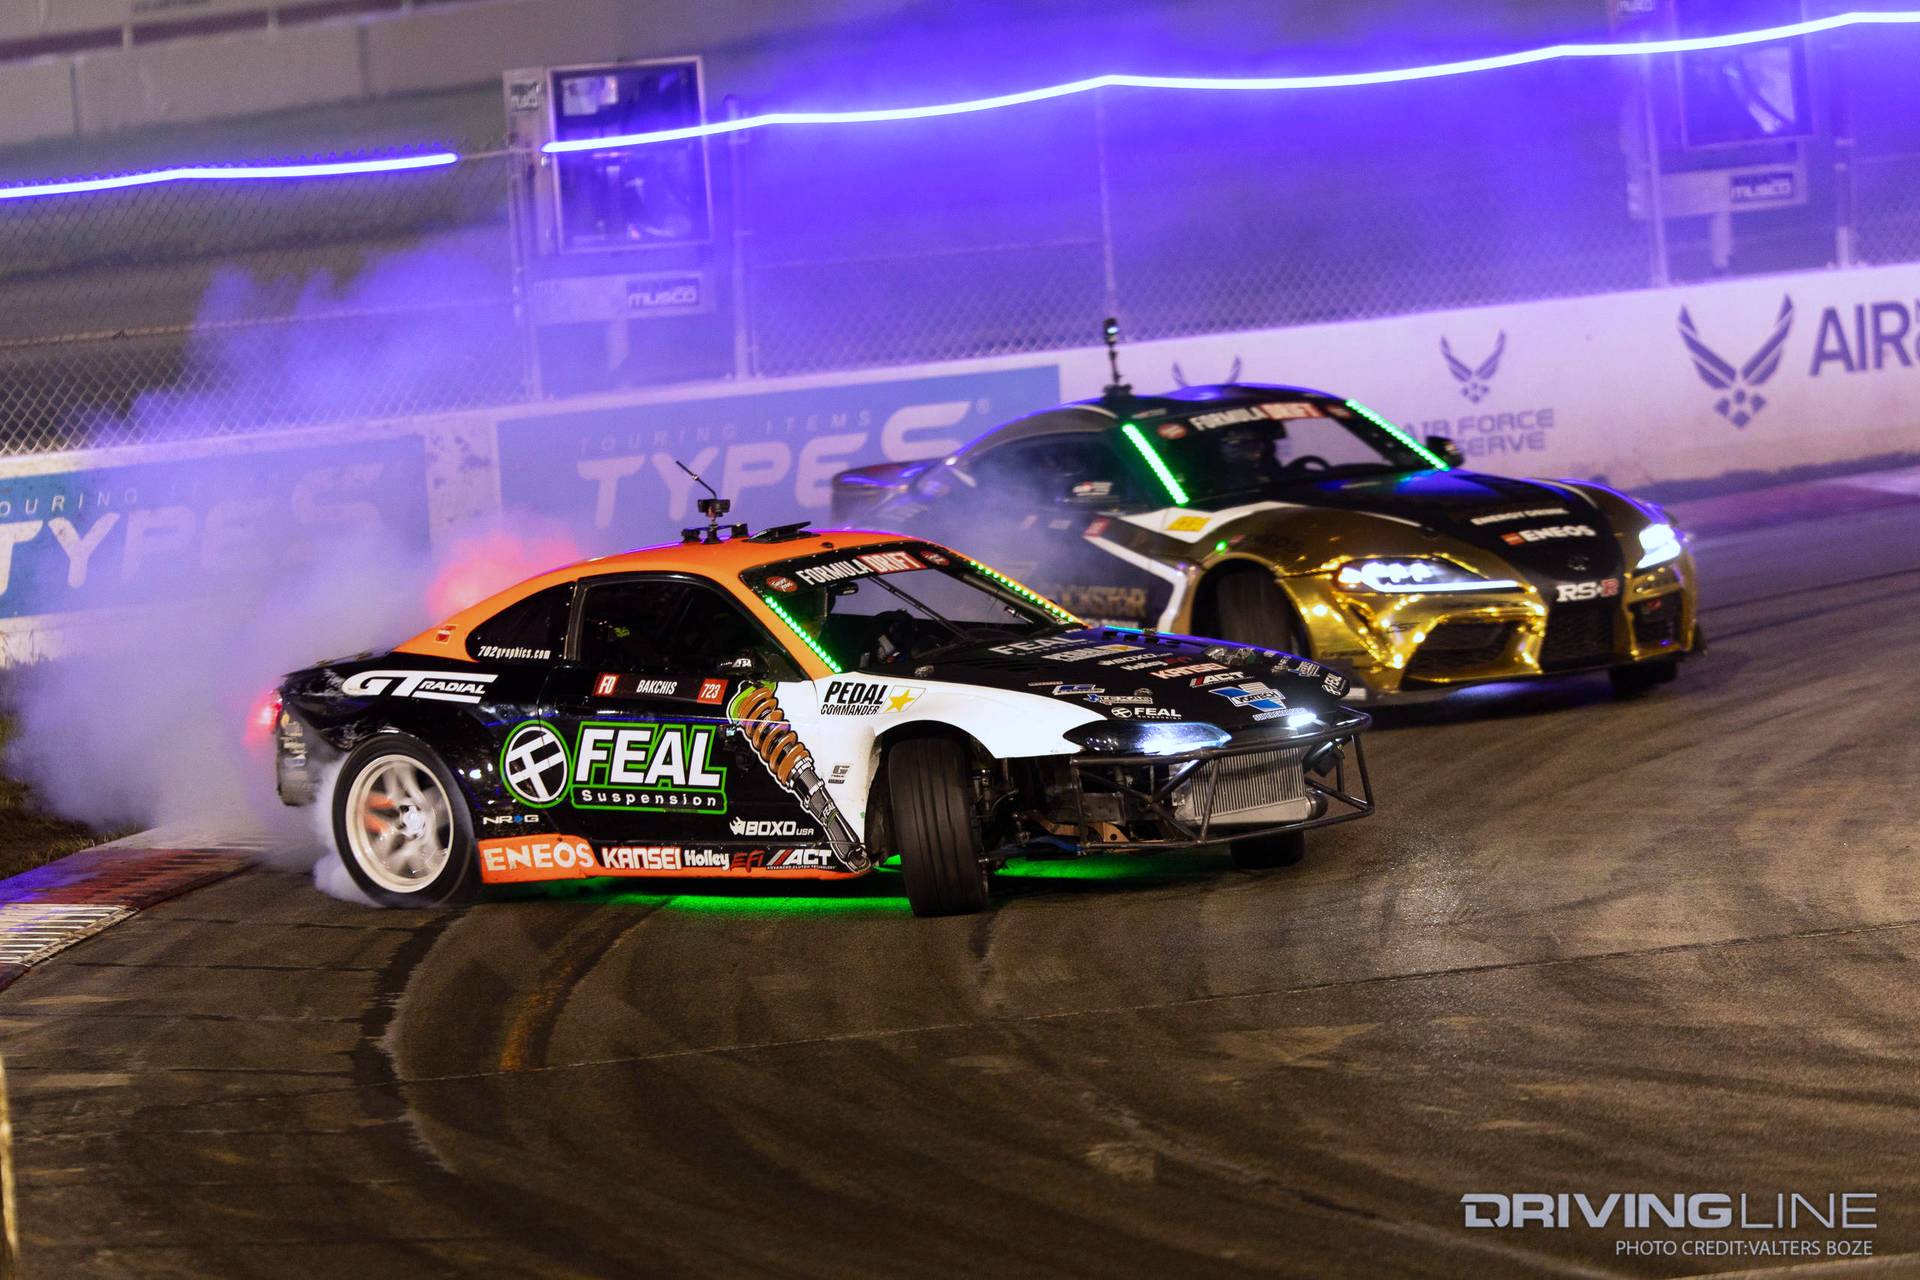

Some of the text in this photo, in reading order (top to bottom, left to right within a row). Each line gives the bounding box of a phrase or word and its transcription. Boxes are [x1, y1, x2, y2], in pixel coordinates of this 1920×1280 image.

[1457, 408, 1554, 434] FORCE
[1454, 431, 1546, 457] SERVE
[1519, 525, 1597, 542] ENEOS
[796, 559, 874, 586] FORMULA
[867, 550, 923, 573] DRIFT
[477, 645, 552, 660] 702graphics.com
[988, 636, 1088, 655] FEAL
[418, 680, 486, 694] RADIAL
[598, 674, 722, 699] FD BAKCHIS 723
[1202, 671, 1246, 685] ACT
[823, 680, 888, 705] PEDAL
[820, 703, 880, 716] COMMANDER
[1134, 707, 1182, 717] FEAL
[575, 728, 721, 787] FEAL
[582, 789, 716, 807] Suspension
[745, 821, 814, 836] BOXO USA
[484, 843, 595, 872] ENEOS
[601, 846, 682, 870] KANSEI
[684, 849, 730, 871] Holley
